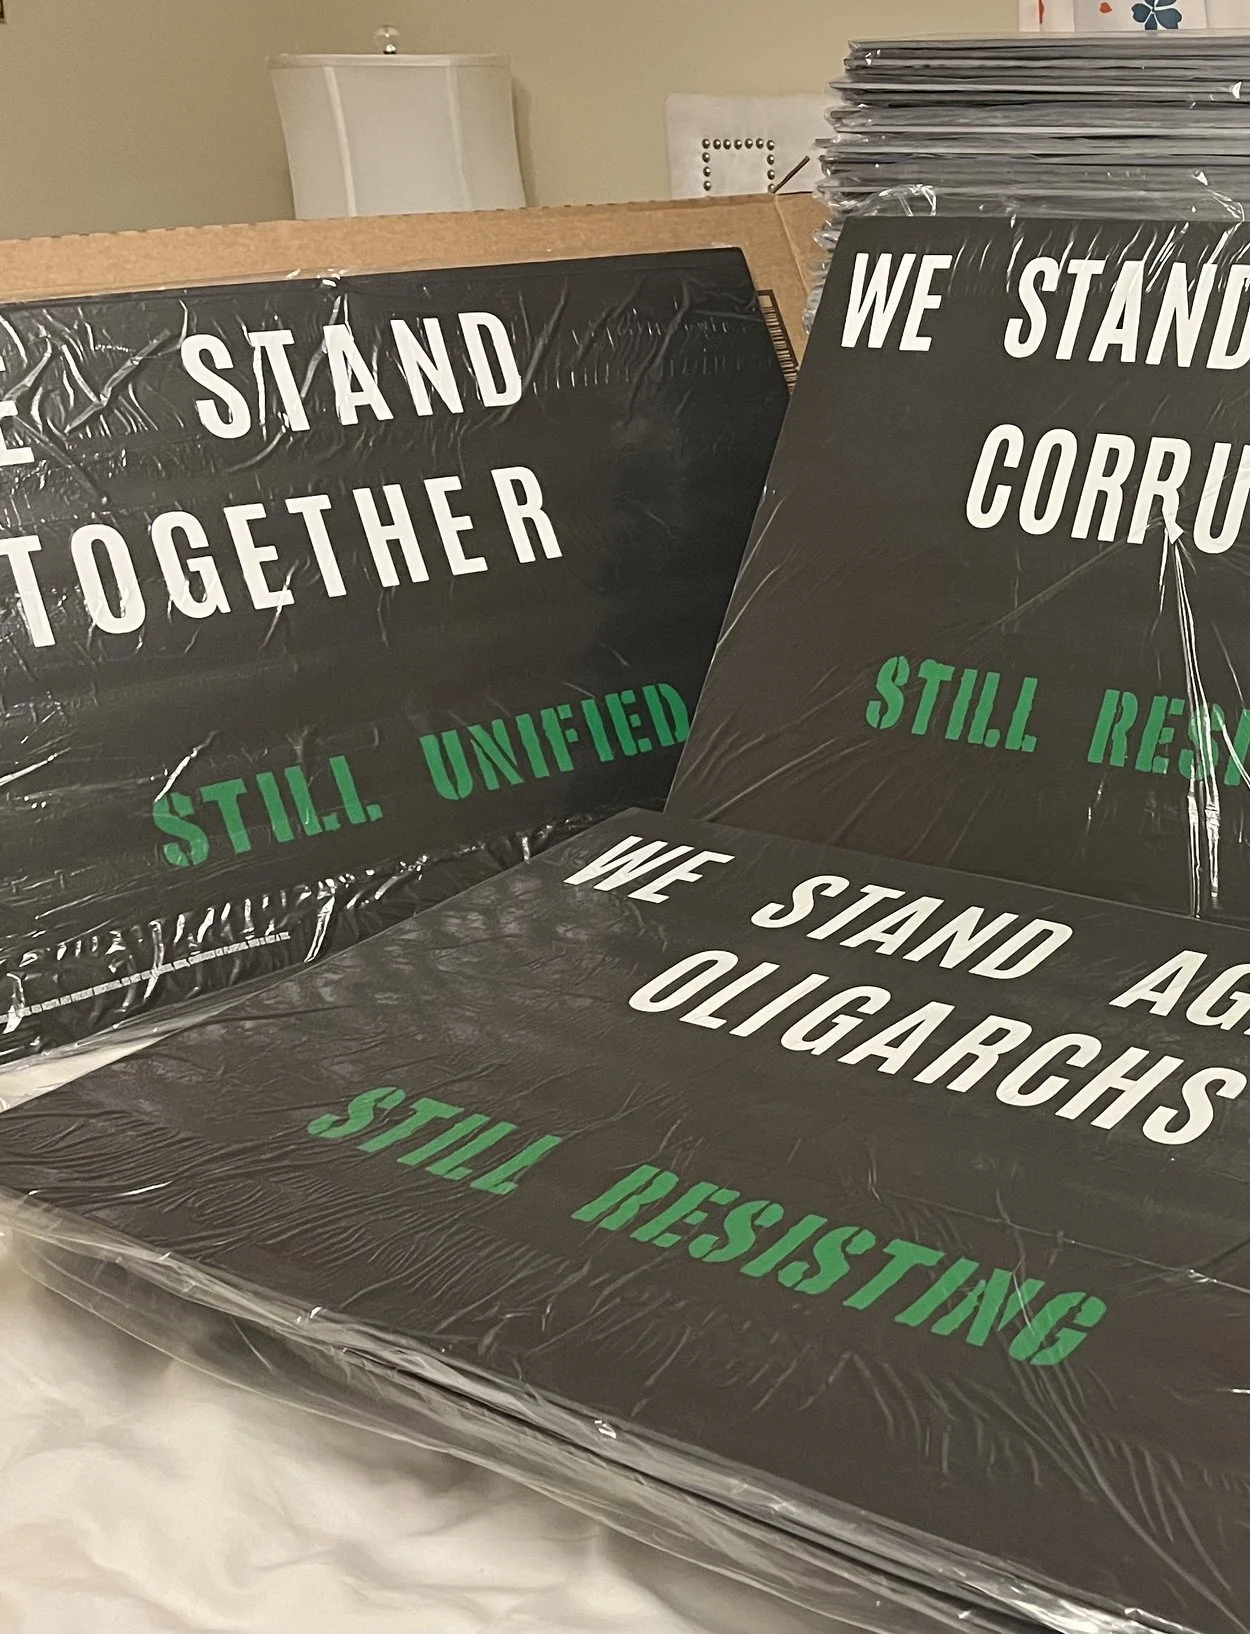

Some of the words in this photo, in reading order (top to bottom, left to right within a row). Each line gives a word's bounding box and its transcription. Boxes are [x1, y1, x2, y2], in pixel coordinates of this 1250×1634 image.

[184, 311, 523, 440] STAND
[840, 252, 953, 352] WE
[0, 466, 563, 648] TOGETHER
[152, 755, 383, 868] STILL
[420, 683, 691, 801] UNIFIED
[866, 656, 1038, 752] STILL
[564, 834, 734, 905] WE
[751, 874, 1073, 980] STAND
[628, 948, 1247, 1146] OLIGARCHS
[306, 1086, 562, 1196] STILL
[571, 1164, 1109, 1367] RESISTING
